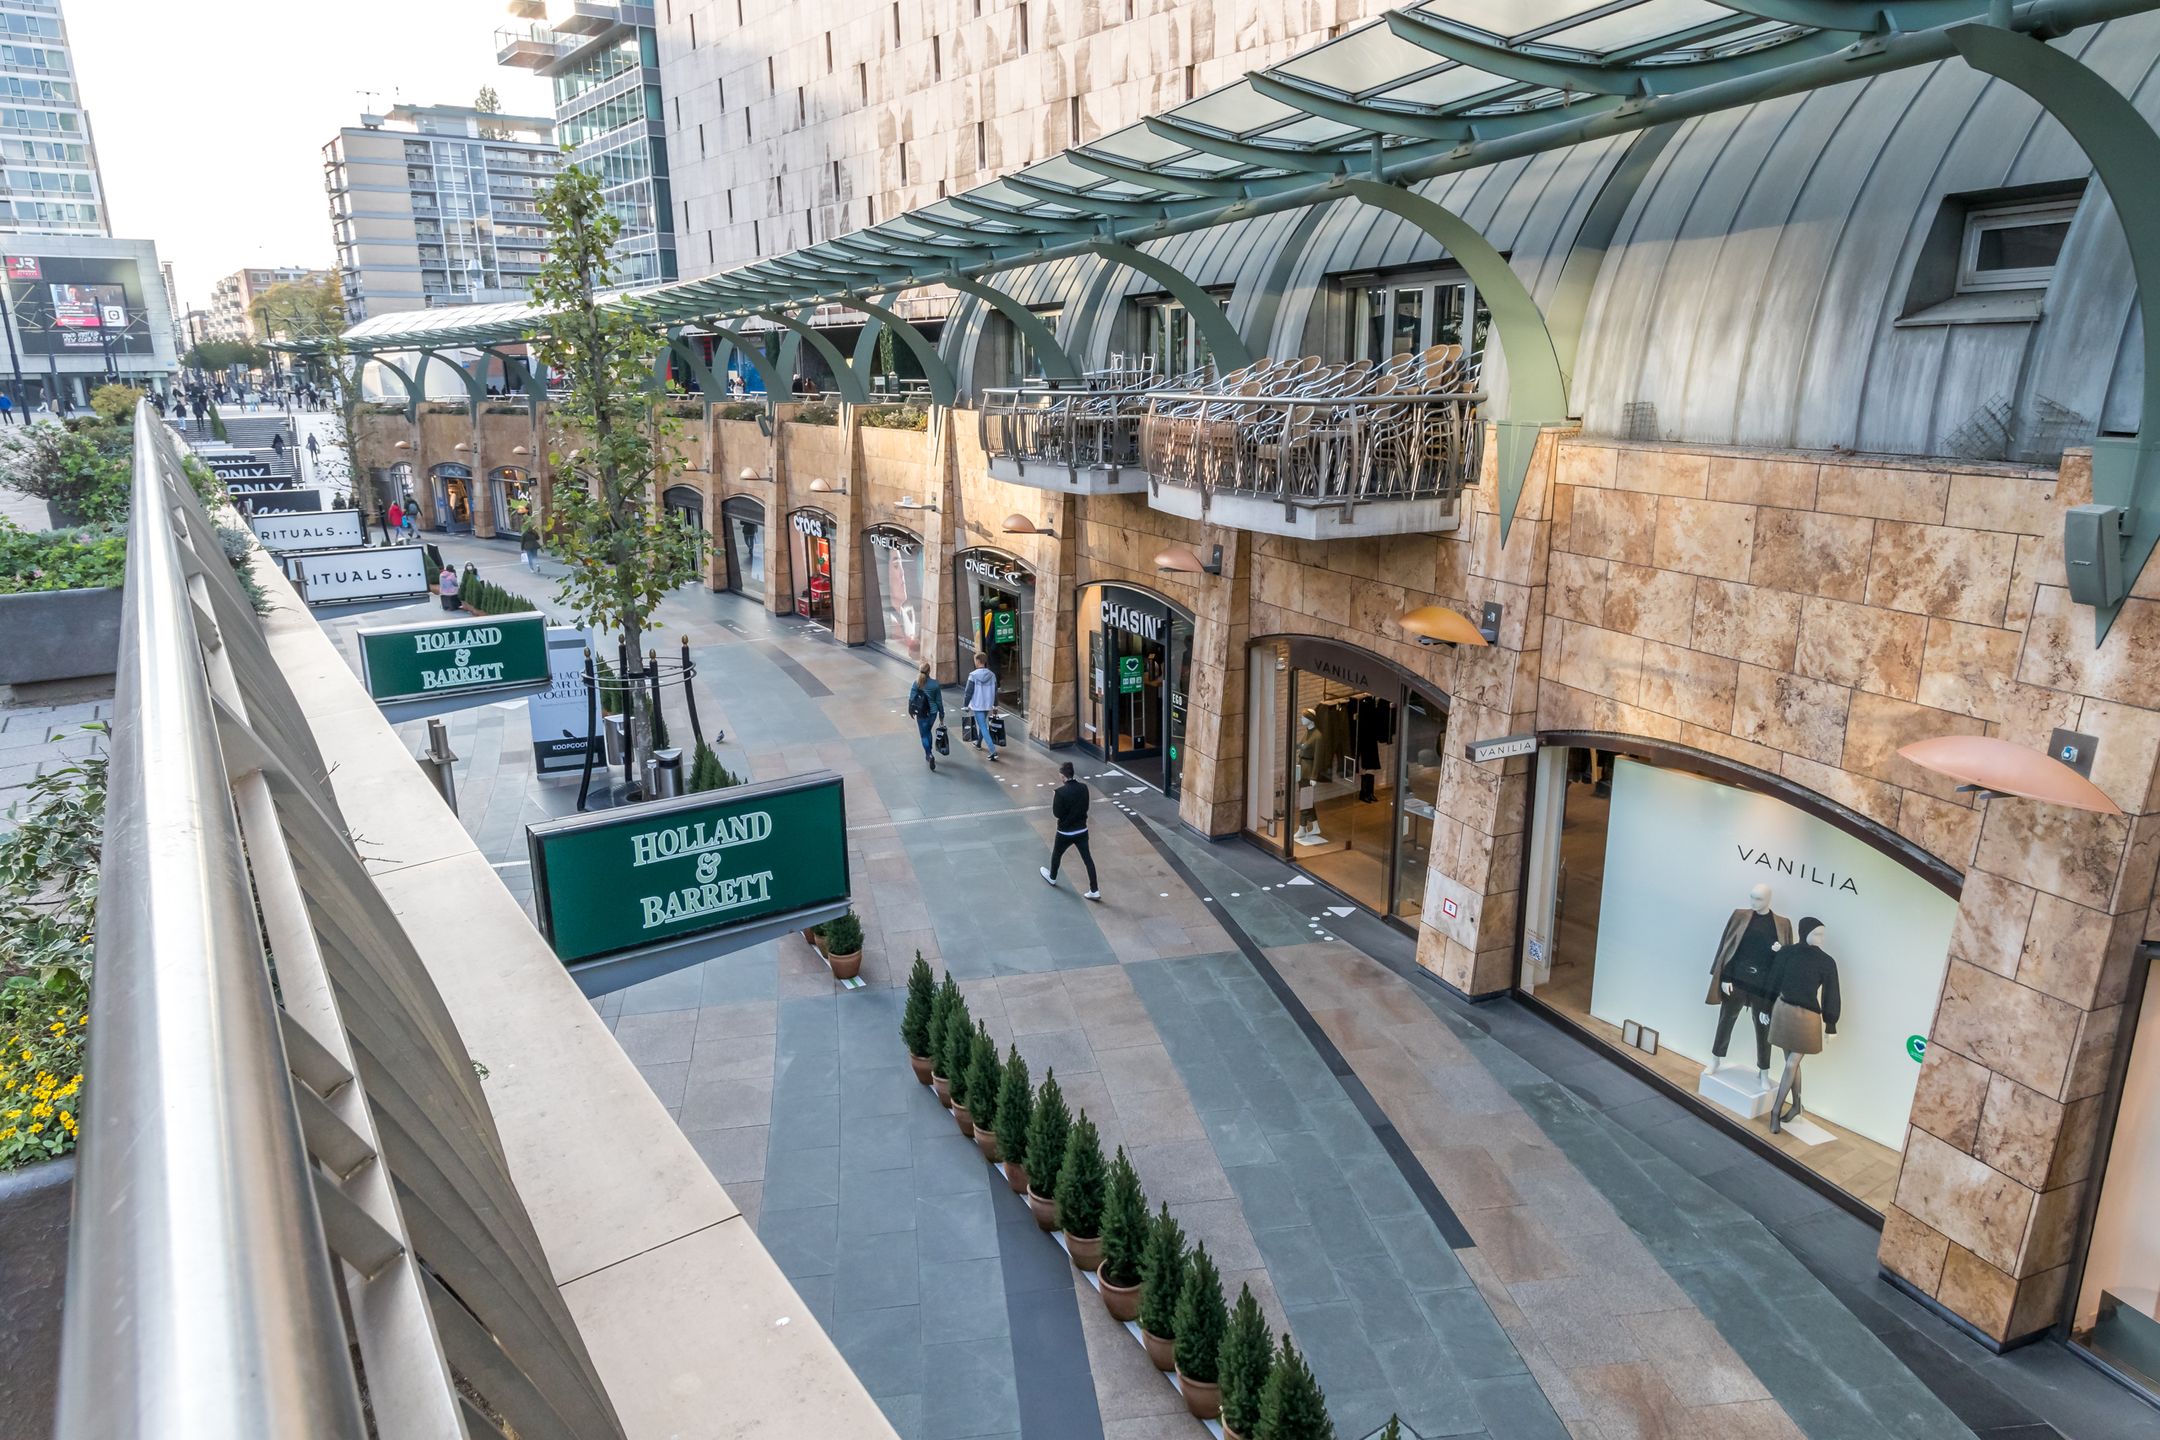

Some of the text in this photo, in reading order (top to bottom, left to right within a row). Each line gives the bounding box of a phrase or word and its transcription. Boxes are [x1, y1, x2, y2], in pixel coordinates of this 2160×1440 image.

[15, 257, 36, 269] JR
[261, 527, 358, 540] RITUALS...
[793, 514, 823, 537] crocs
[964, 558, 1001, 580] O'NEILL
[1101, 600, 1162, 641] CHASIN'
[414, 627, 503, 653] HOLLAND
[454, 649, 471, 667] &
[421, 662, 504, 690] BARRETT
[1313, 657, 1370, 688] VANILIA
[1479, 741, 1532, 758] VANILIA
[631, 810, 772, 867] HOLLAND
[695, 852, 722, 884] &
[1737, 844, 1859, 896] VANILIA
[640, 870, 774, 929] BARRETT
